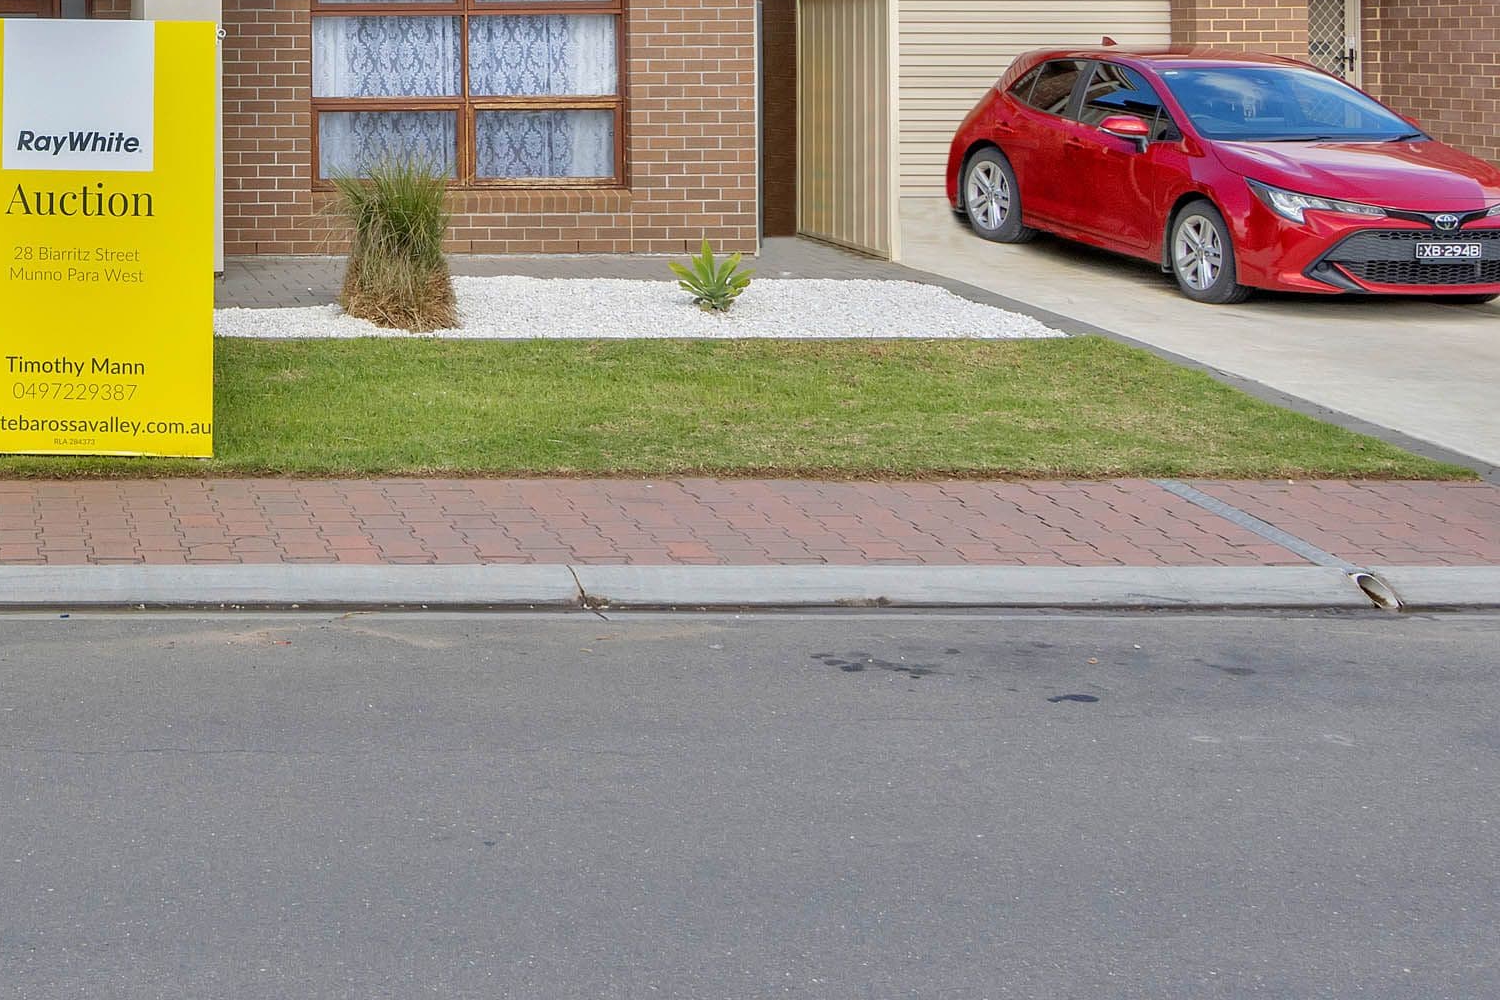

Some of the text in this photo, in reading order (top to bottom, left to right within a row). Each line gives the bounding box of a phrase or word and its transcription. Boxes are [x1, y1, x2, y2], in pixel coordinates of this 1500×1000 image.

[6, 182, 155, 217] Auction
[14, 246, 140, 262] 28 Biarritz Street
[10, 267, 144, 283] Munno Para West
[6, 356, 145, 376] Timothy Mann
[12, 382, 137, 400] 0497229387
